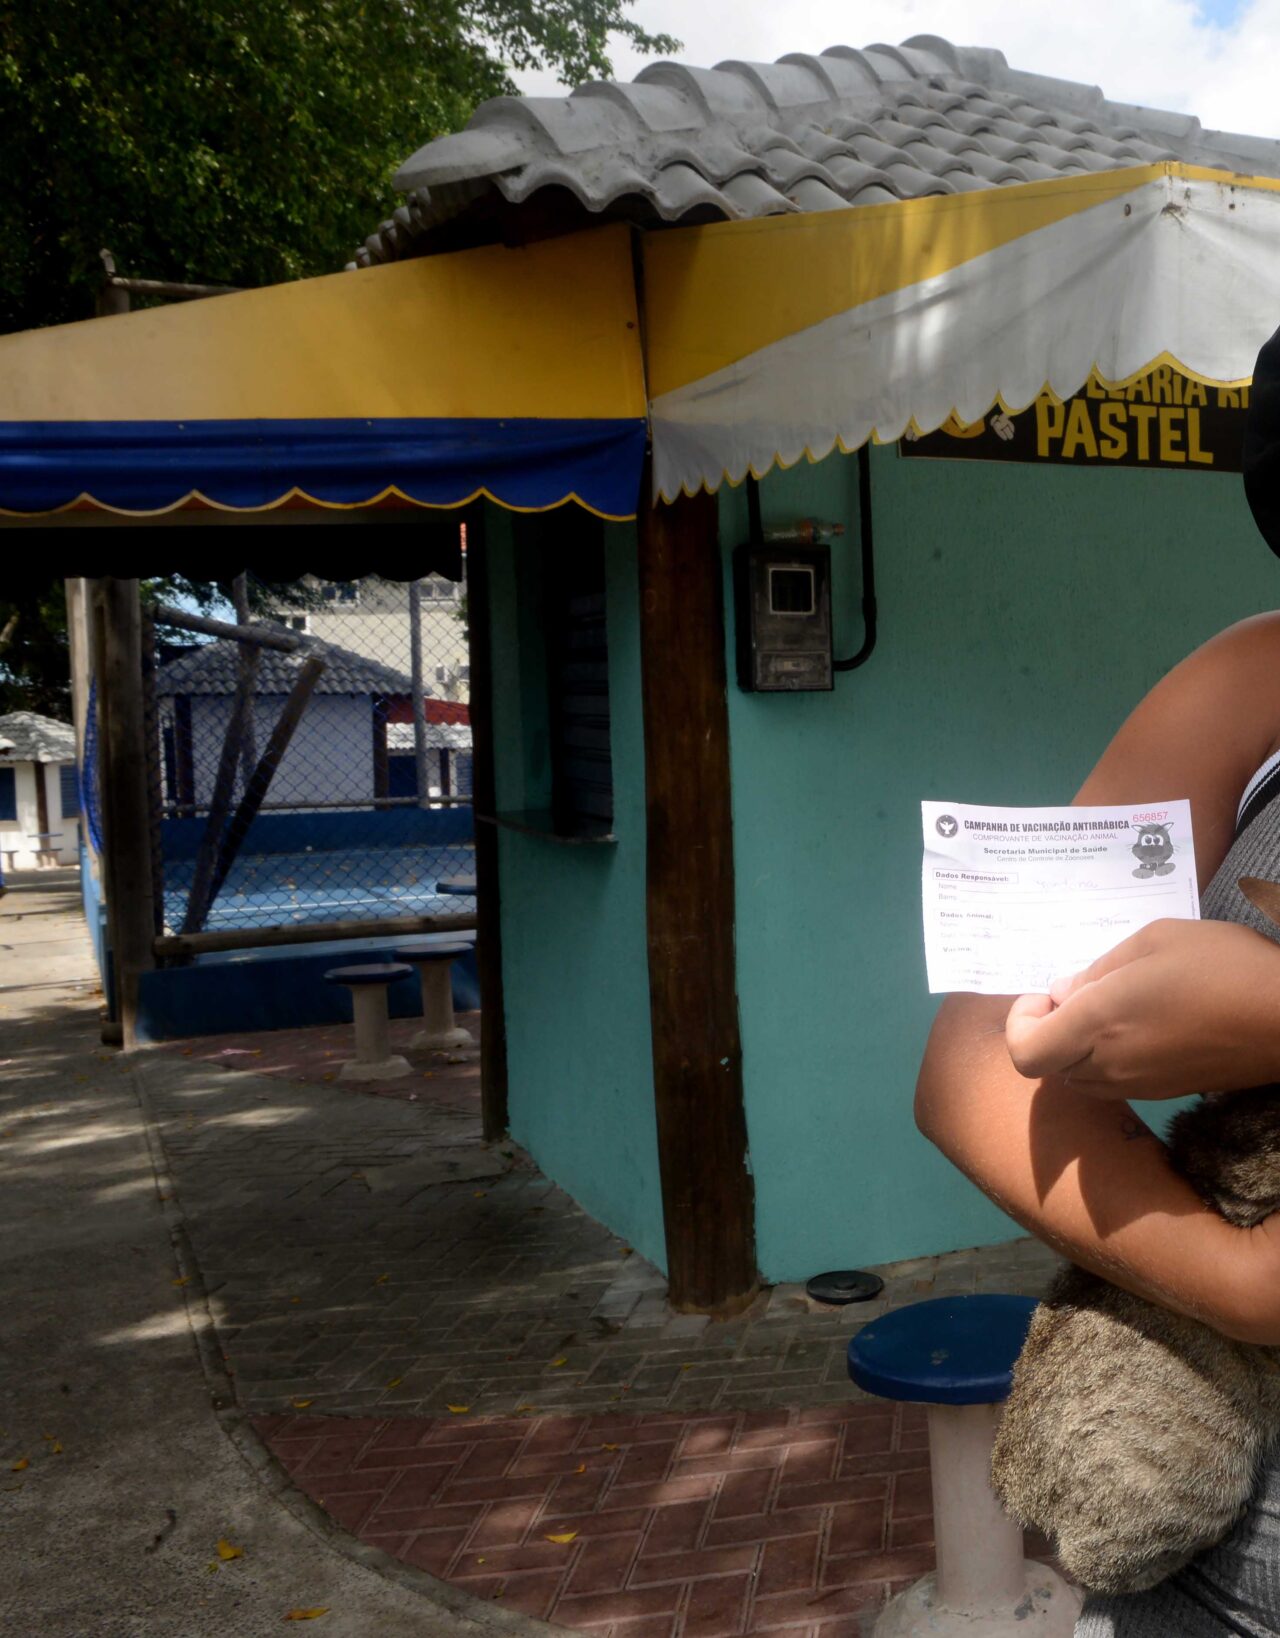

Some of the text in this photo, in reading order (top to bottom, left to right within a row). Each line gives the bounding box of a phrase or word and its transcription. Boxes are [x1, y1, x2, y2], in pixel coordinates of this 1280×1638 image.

[1036, 396, 1214, 465] PASTEL
[964, 819, 1130, 832] CAMPANHA DE VACINAÇÃO ANTIRRÁBICA
[972, 832, 1118, 842] COMPROVANTE DE VACINAÇÃO ANIMAL
[983, 847, 1026, 855] Secretaria
[1028, 847, 1068, 855] Municipal
[1082, 845, 1108, 853] Saúde
[935, 871, 959, 879] Dados
